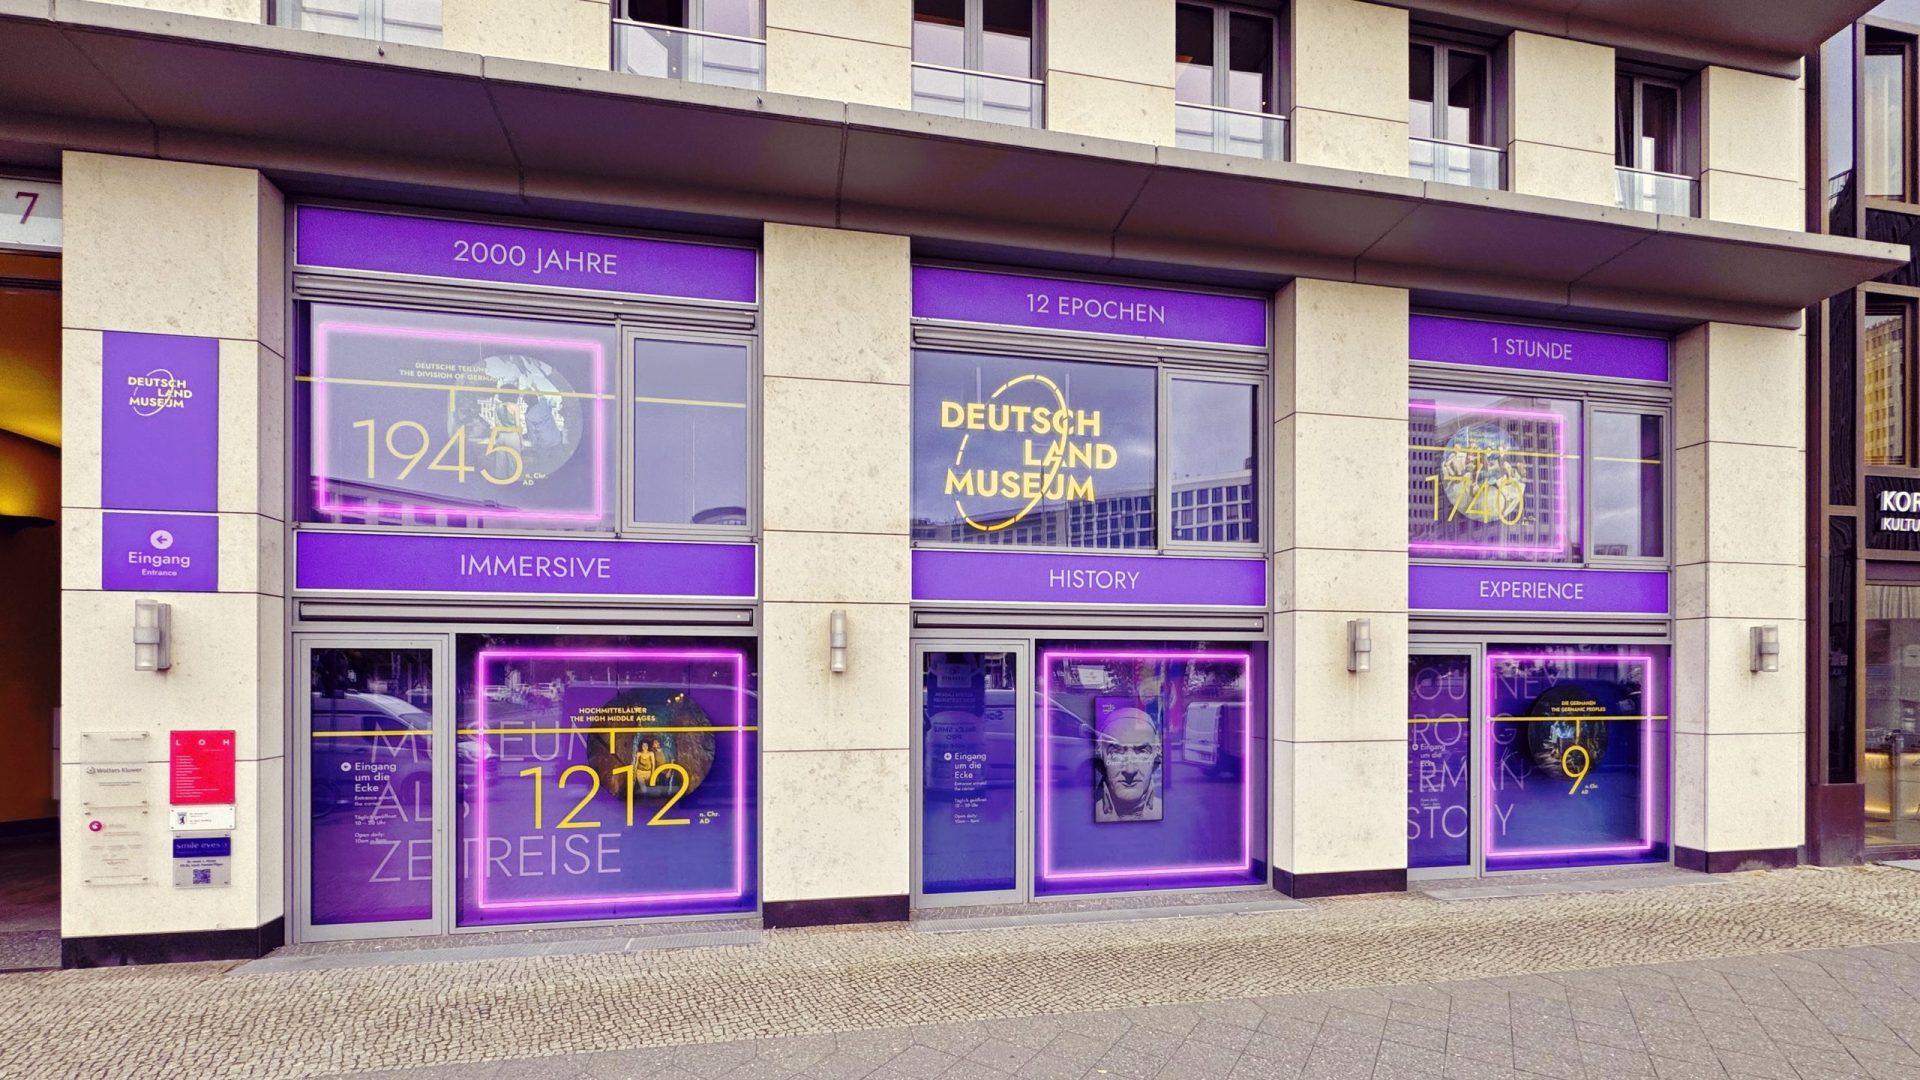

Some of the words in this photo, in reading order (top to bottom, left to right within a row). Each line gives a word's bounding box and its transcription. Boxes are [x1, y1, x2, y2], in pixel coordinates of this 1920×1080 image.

[14, 191, 40, 225] 7
[453, 240, 526, 267] 2000
[532, 247, 617, 275] JAHRE
[1026, 293, 1049, 313] 12
[1058, 296, 1165, 324] EPOCHEN
[1491, 337, 1499, 354] 1
[1505, 338, 1573, 361] STUNDE
[127, 376, 187, 389] DEUTSCH
[157, 388, 193, 399] LAND
[129, 396, 185, 408] MUSEUM
[941, 400, 1100, 437] DEUTSCH
[353, 418, 524, 486] 1945
[1024, 439, 1118, 470] LAND
[944, 467, 1096, 502] MUSEUM
[1425, 474, 1524, 526] 1740
[128, 551, 191, 568] Eingang
[461, 554, 611, 579] IMMERSIVE
[141, 568, 178, 577] Entrance
[1049, 568, 1140, 590] HISTORY
[1480, 580, 1584, 600] EXPERIENCE
[579, 706, 647, 714] HOCHMITTELALTER
[354, 762, 397, 772] Eingang
[954, 752, 987, 762] Eingang
[969, 760, 982, 769] die
[374, 772, 390, 781] die
[954, 771, 974, 779] Ecke
[1561, 744, 1590, 795] 9
[354, 783, 379, 793] Ecke
[519, 763, 691, 830] 1212
[369, 832, 622, 883] ZETREISE
